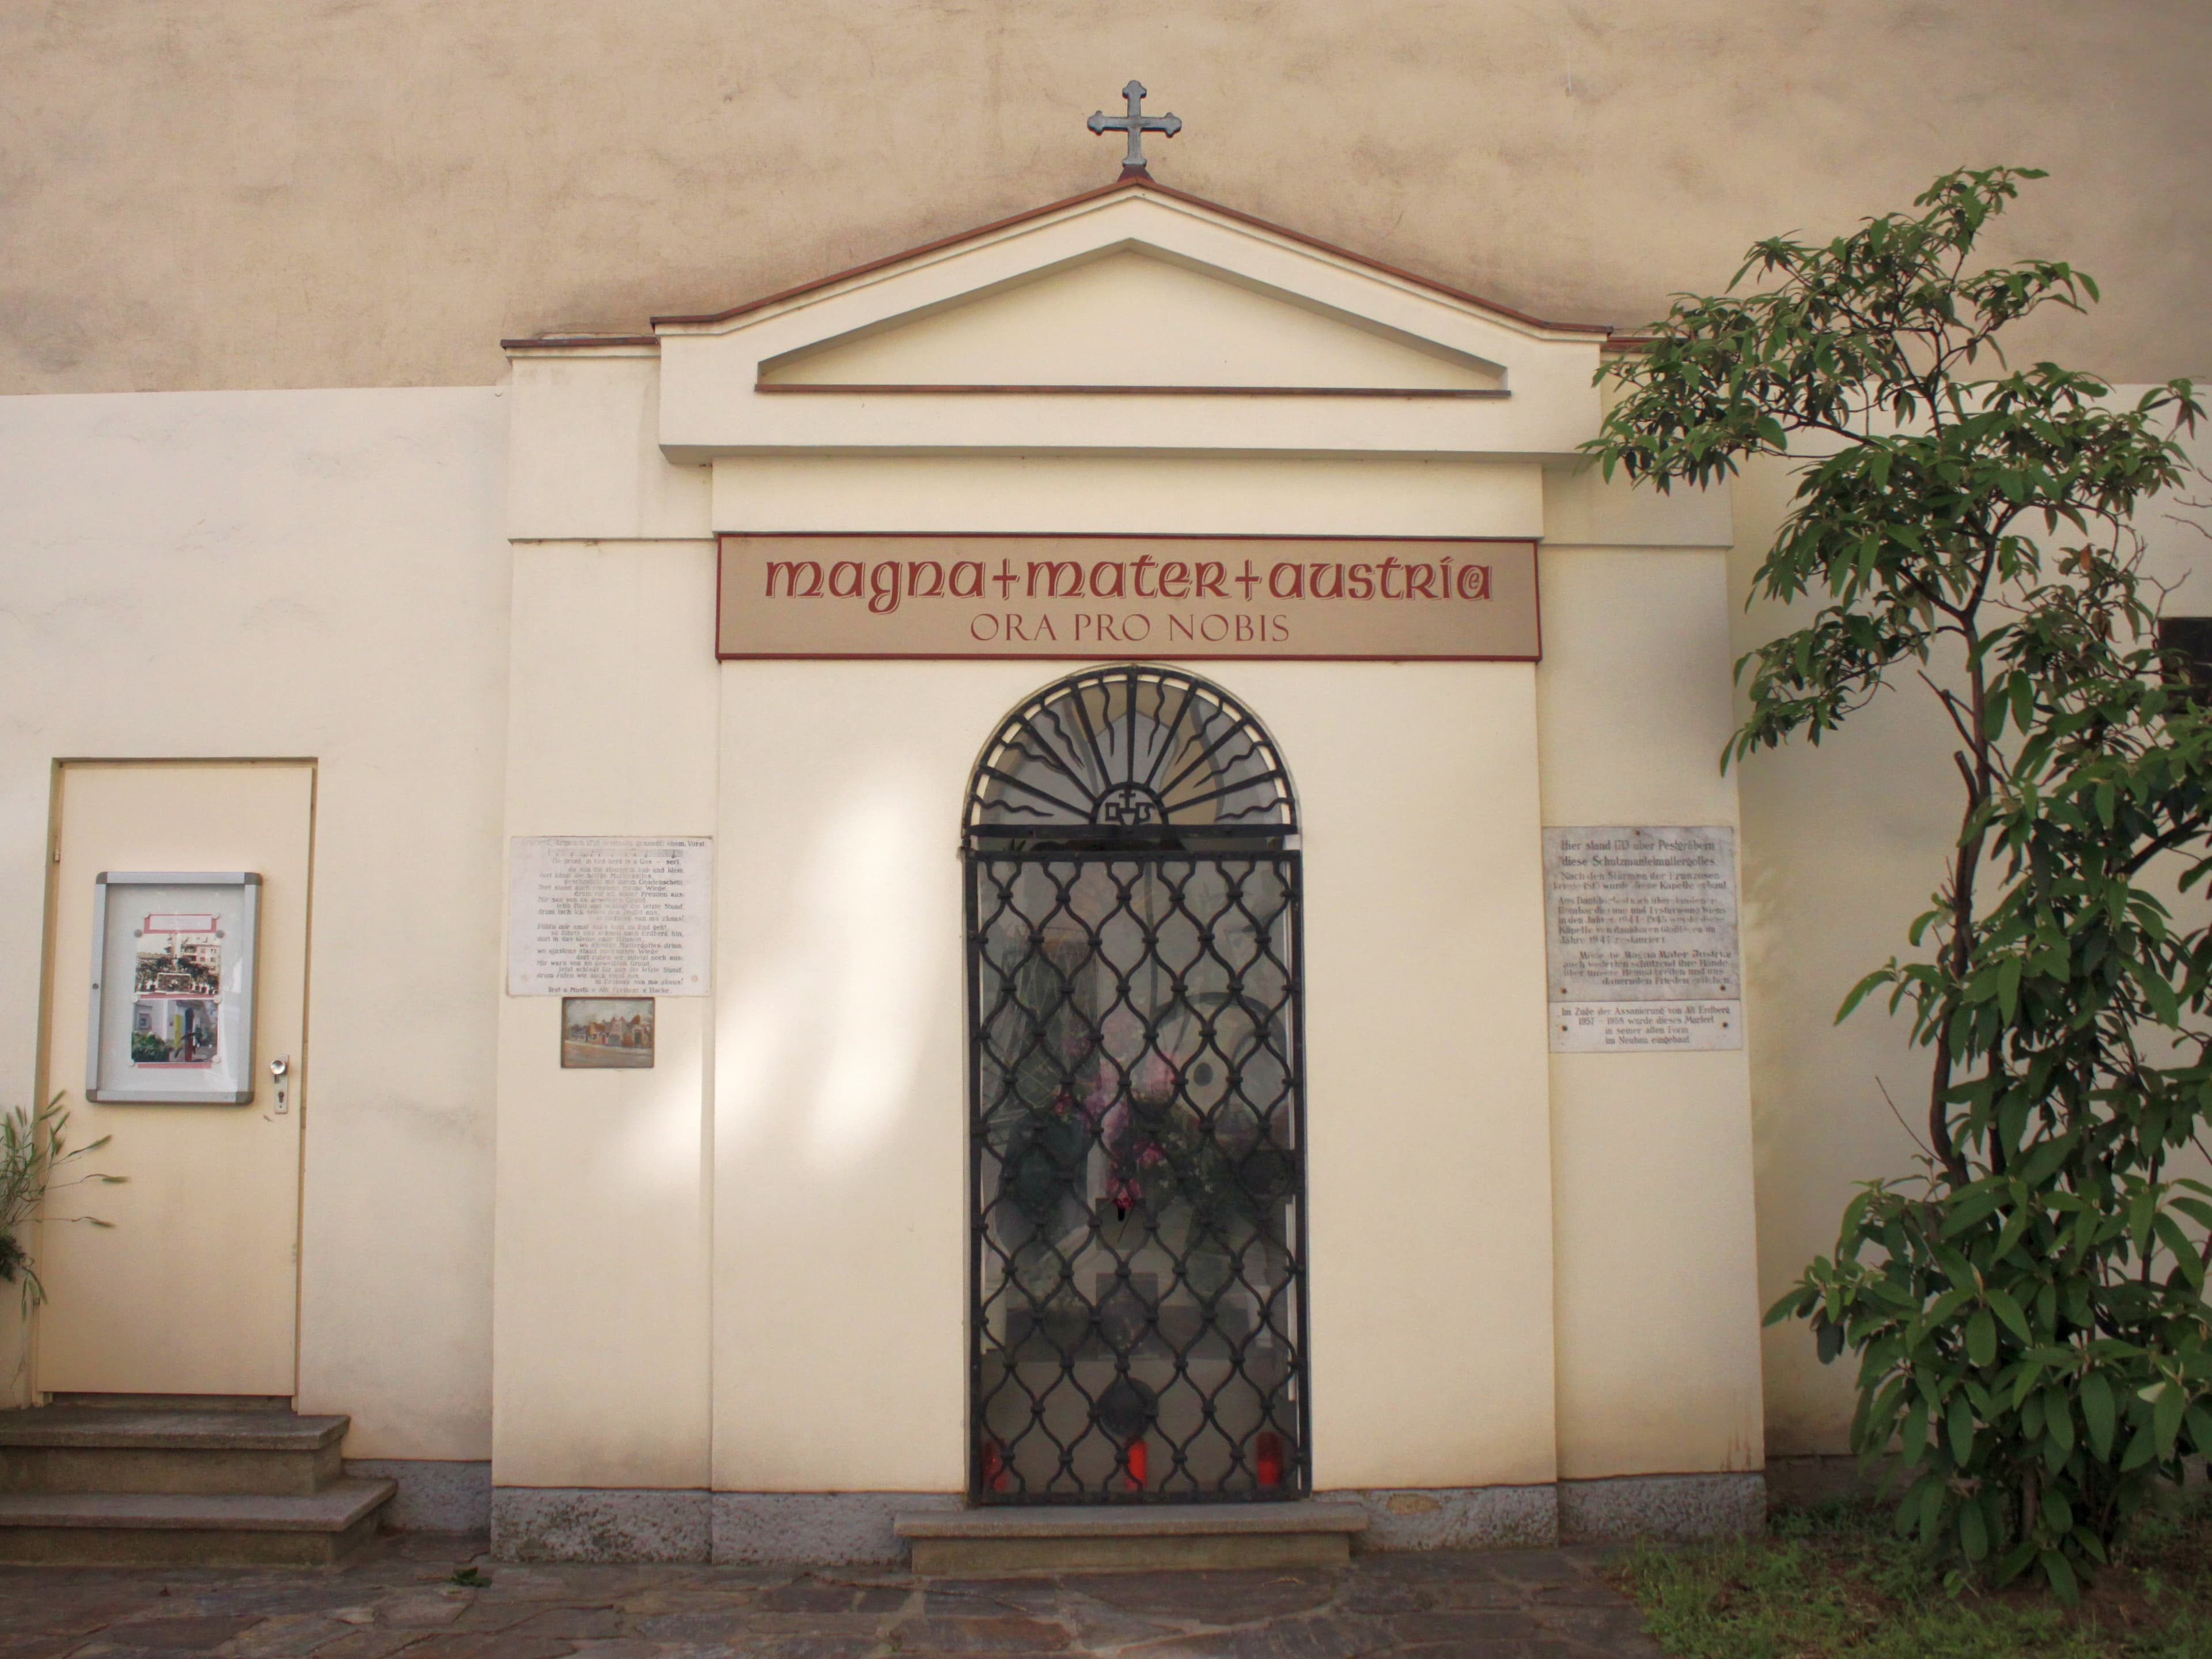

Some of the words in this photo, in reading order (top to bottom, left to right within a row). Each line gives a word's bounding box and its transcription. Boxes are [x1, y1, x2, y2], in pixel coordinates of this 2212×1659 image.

[971, 613, 1058, 642] ORA
[1075, 613, 1151, 642] PRO
[1168, 613, 1290, 642] NOBIS
[1561, 1008, 1572, 1016] Im
[1574, 1007, 1595, 1016] Zuge
[1597, 1007, 1612, 1016] der
[1614, 1007, 1665, 1016] Assanierung
[1698, 1006, 1731, 1014] Erdberg
[1627, 1016, 1654, 1025] wurde
[1656, 1016, 1683, 1024] dieses
[1605, 1027, 1613, 1035] in
[1645, 1026, 1665, 1034] alten
[1667, 1025, 1689, 1034] Form
[1605, 1036, 1616, 1045] im
[1618, 1036, 1649, 1044] Neubau
[1651, 1035, 1690, 1045] eingebaut
